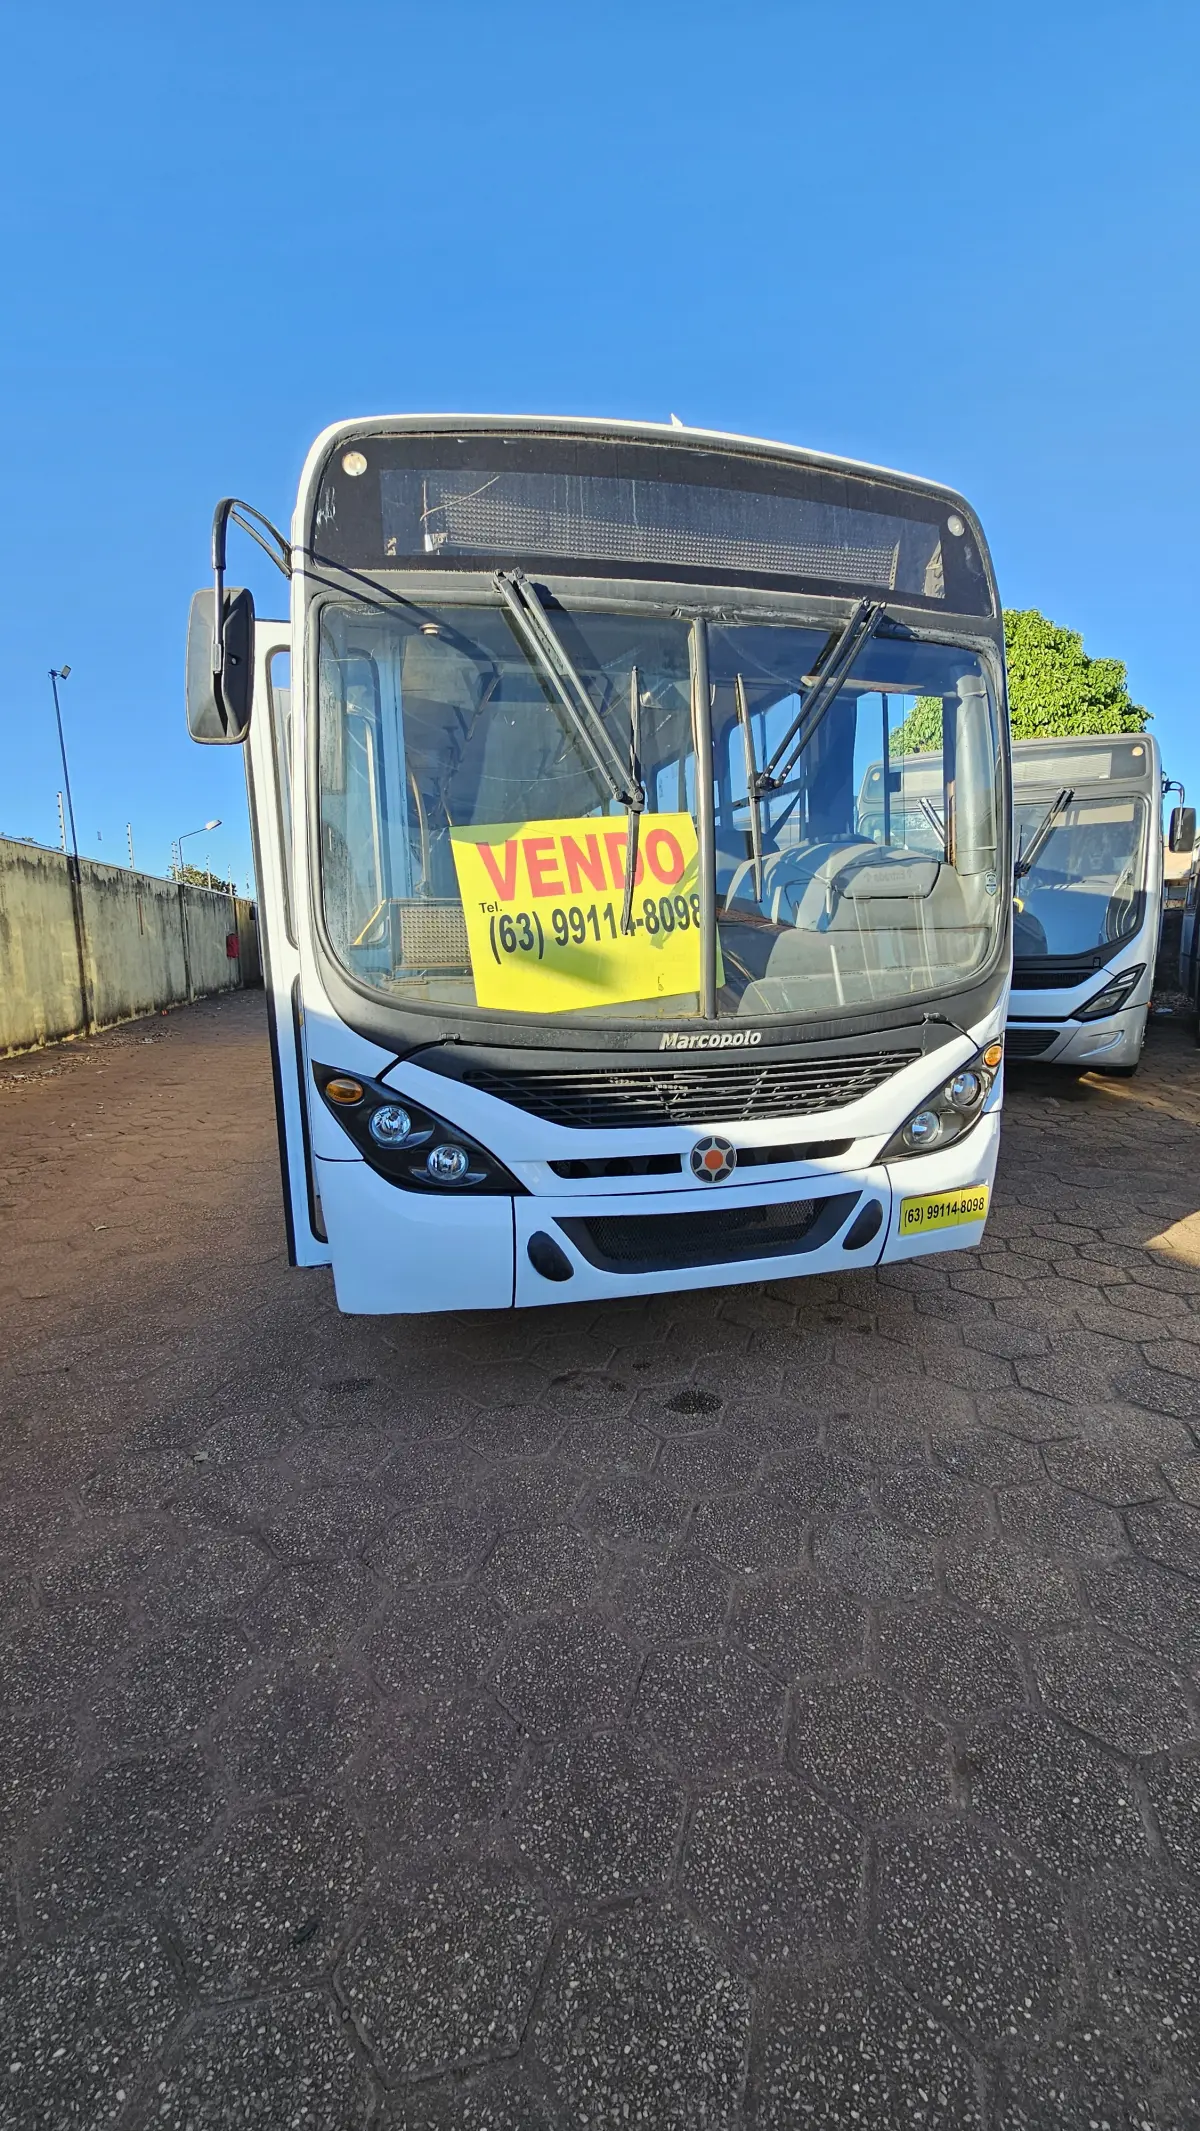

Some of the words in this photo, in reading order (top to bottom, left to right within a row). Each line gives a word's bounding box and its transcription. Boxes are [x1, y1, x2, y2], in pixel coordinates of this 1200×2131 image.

[475, 828, 685, 901] VENDO
[478, 900, 503, 914] Tel.
[489, 911, 545, 965] (63)
[659, 1030, 762, 1051] Marcopolo
[904, 1206, 924, 1228] (63)
[927, 1197, 985, 1220] 99114-8098
